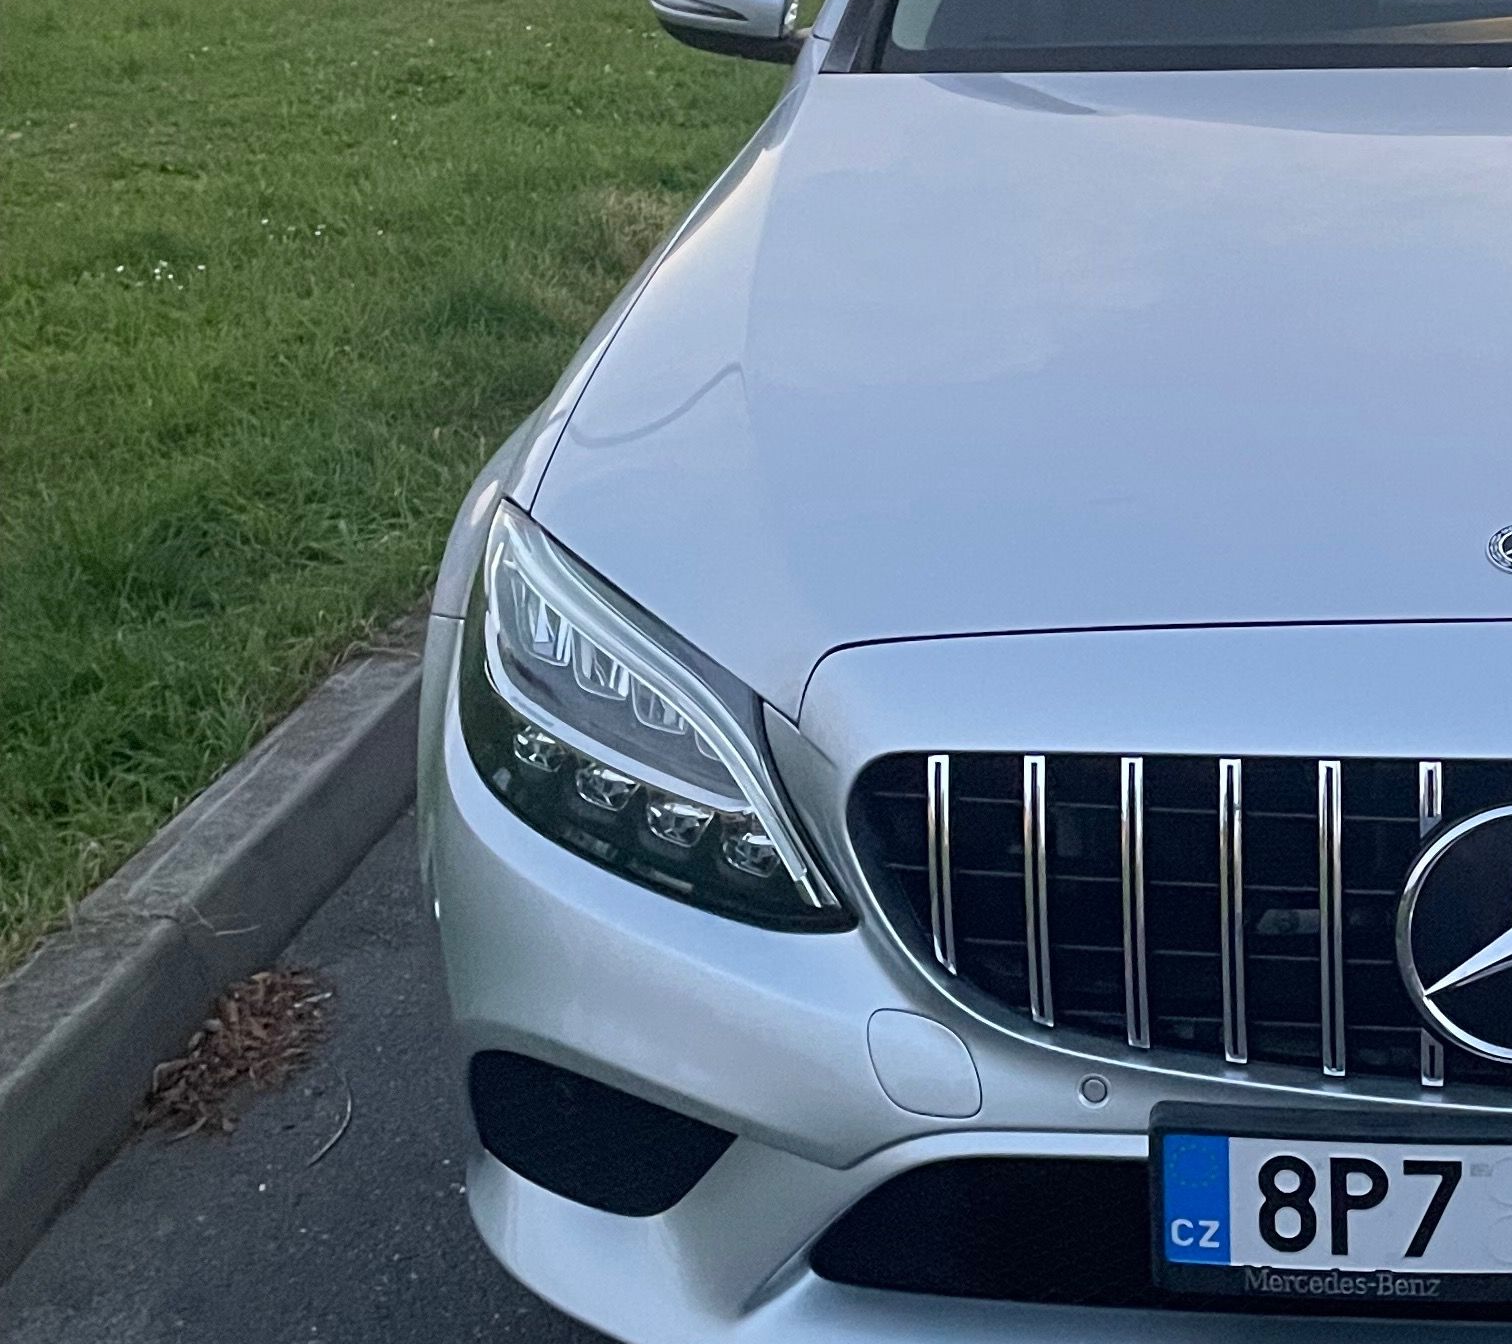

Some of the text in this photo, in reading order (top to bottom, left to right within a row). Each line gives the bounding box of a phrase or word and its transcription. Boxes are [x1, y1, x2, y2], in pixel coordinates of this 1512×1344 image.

[1258, 1155, 1462, 1257] 8P7
[1171, 1218, 1220, 1248] CZ
[1243, 1268, 1441, 1296] Mercedes-Benz
